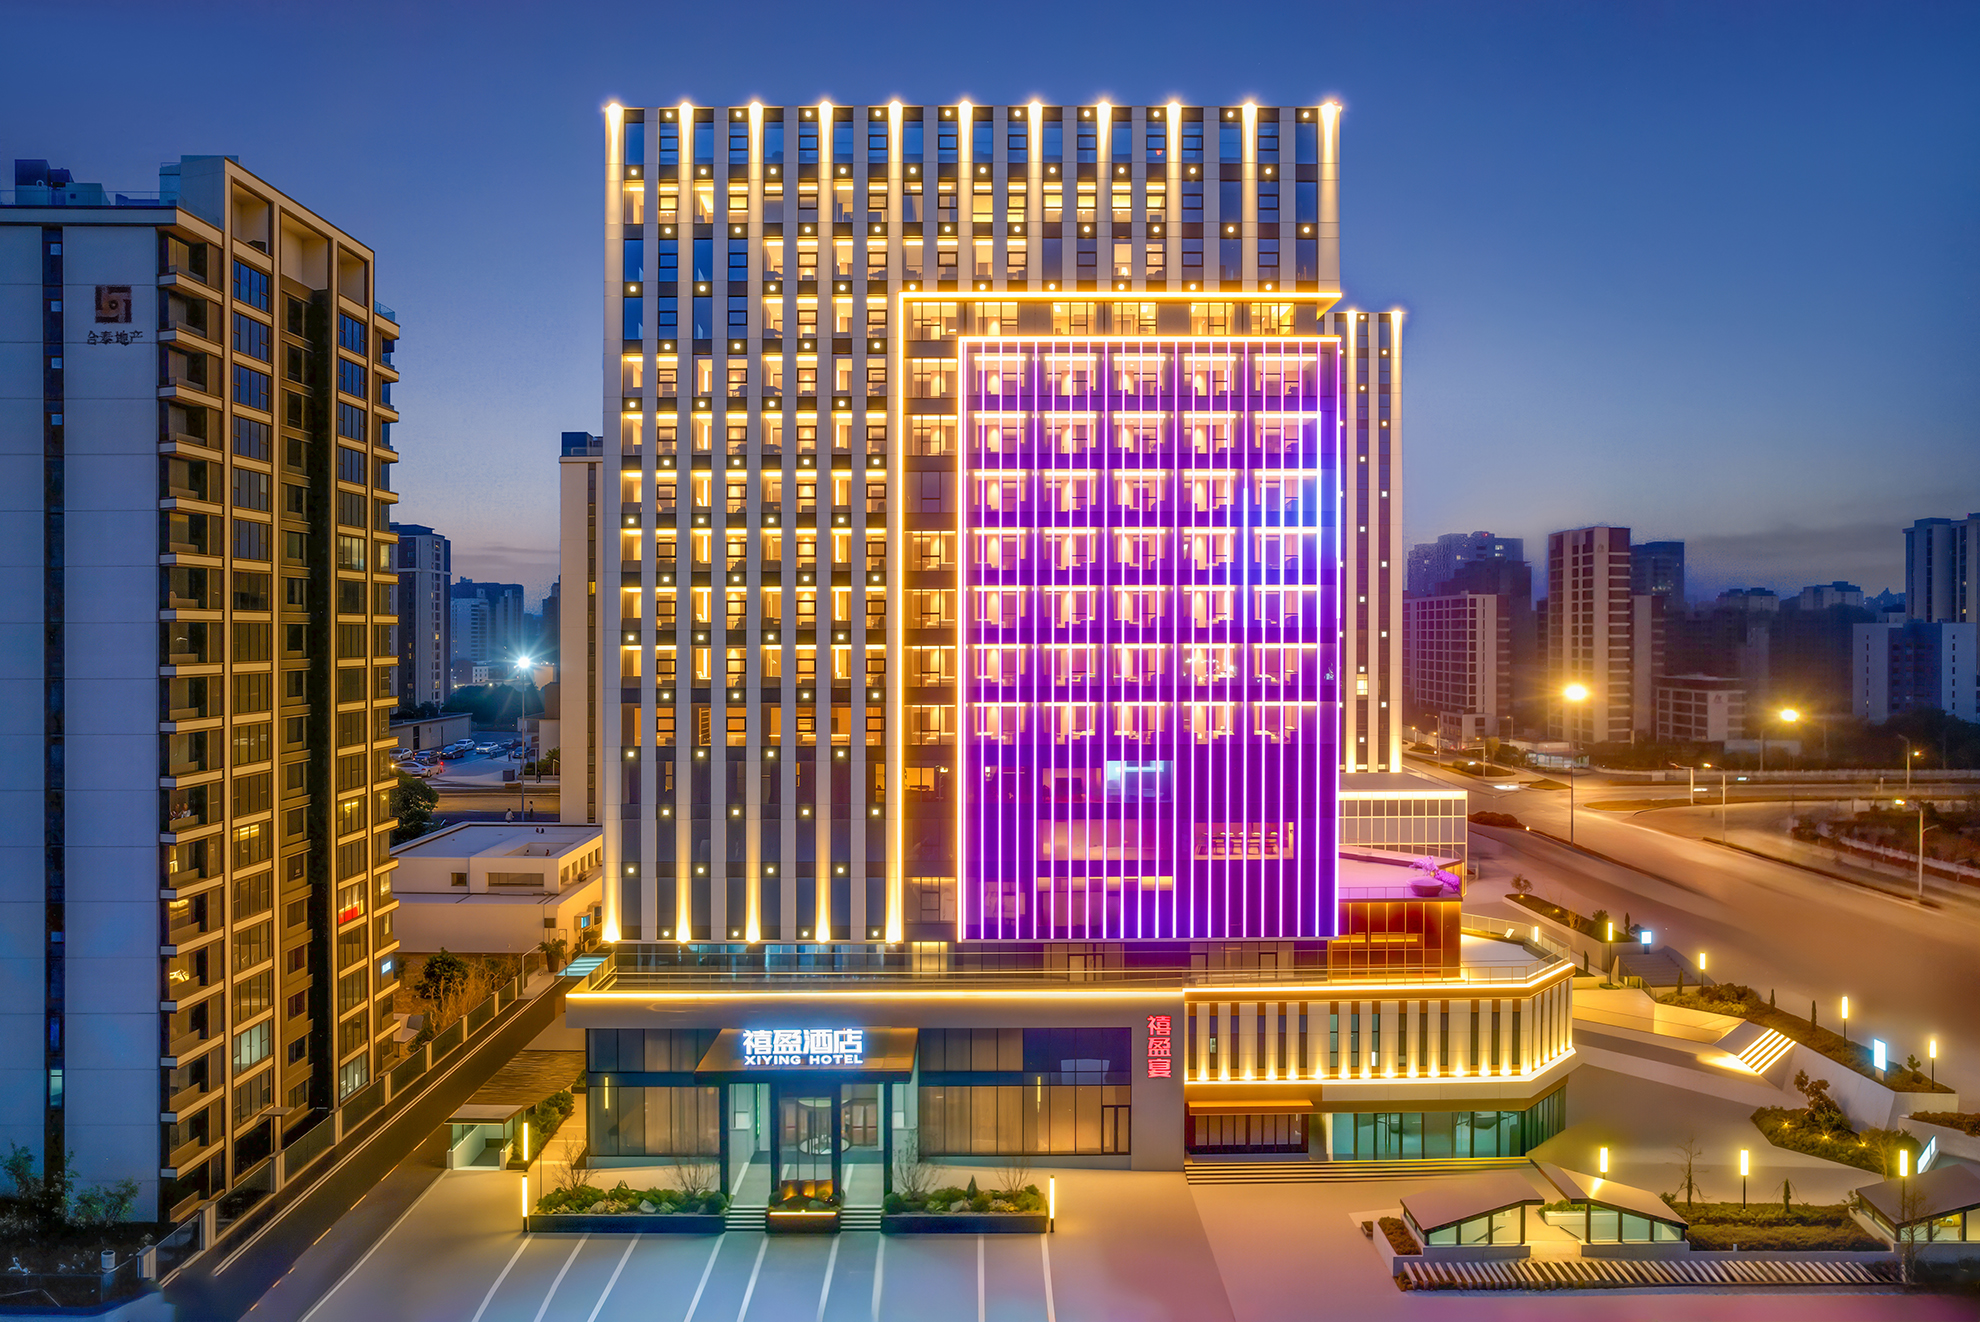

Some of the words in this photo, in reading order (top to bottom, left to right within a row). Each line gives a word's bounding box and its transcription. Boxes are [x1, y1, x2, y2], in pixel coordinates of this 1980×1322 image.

[743, 1029, 863, 1055] 禧盈酒店
[1147, 1015, 1172, 1078] 禧盈宴
[744, 1055, 801, 1066] XIYING
[809, 1055, 863, 1065] HOTEL
